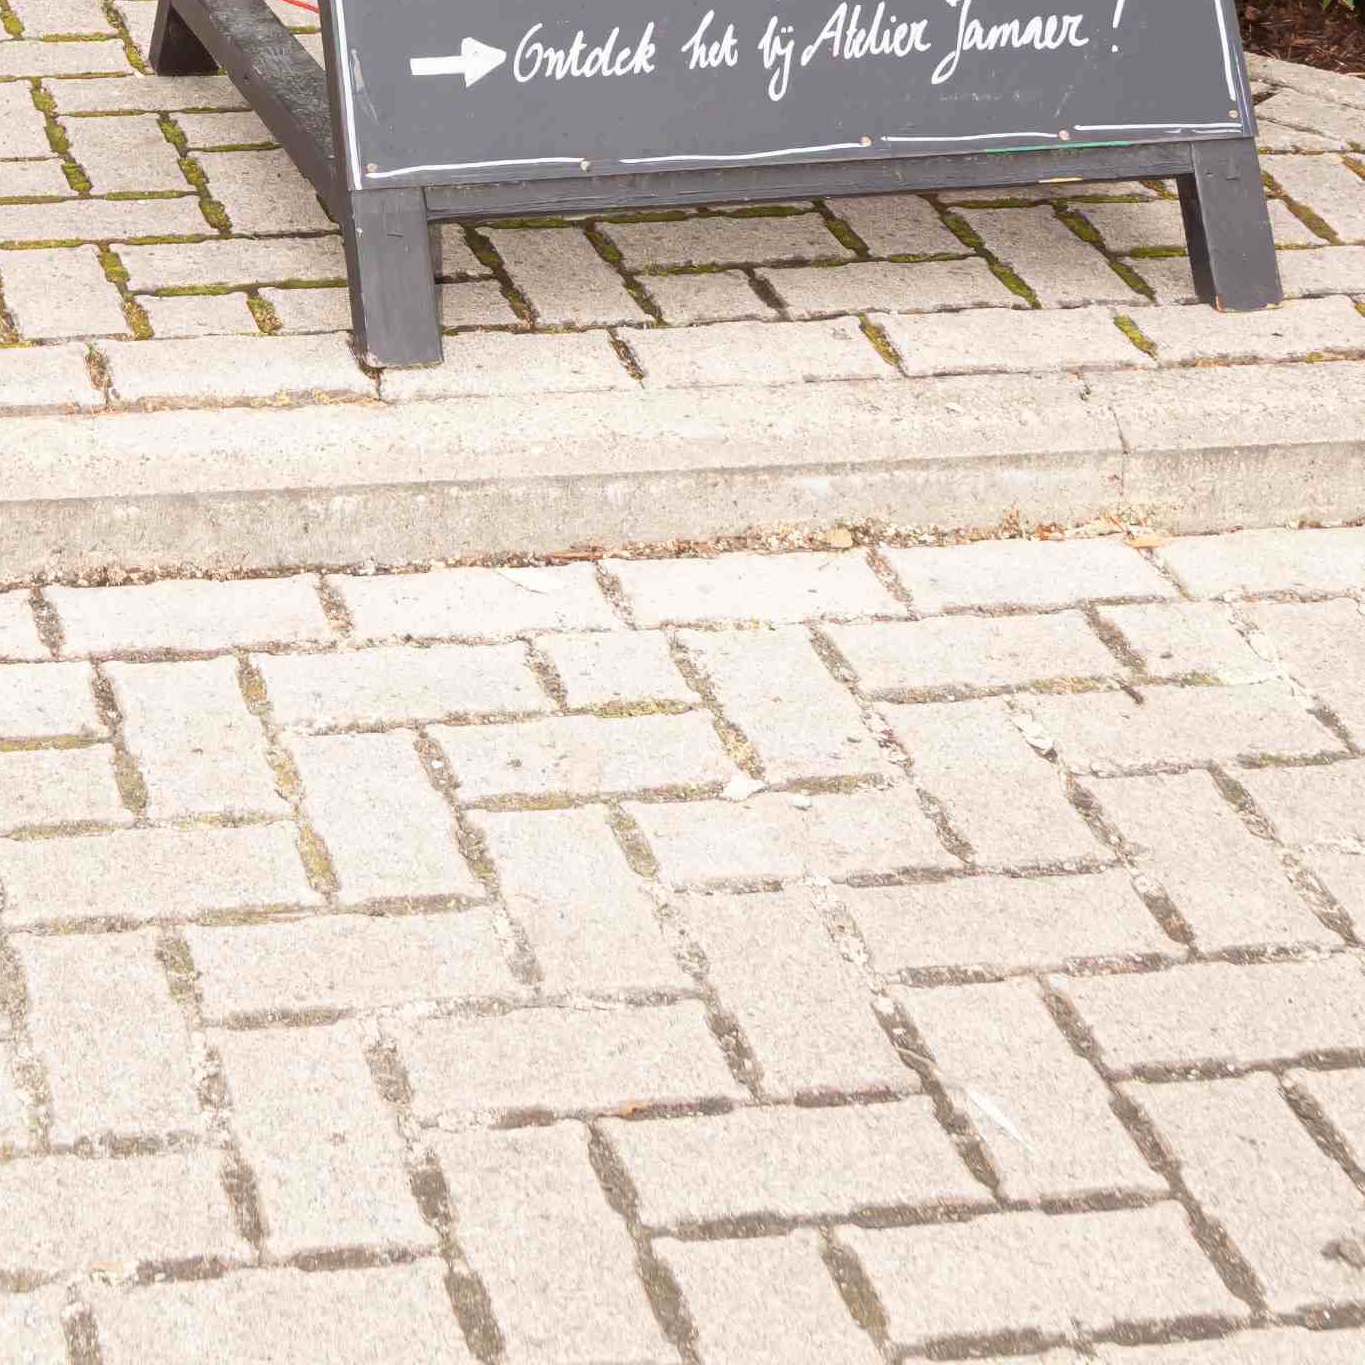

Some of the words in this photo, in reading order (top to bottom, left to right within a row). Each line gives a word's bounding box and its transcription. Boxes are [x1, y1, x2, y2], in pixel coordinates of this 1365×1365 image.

[513, 22, 656, 83] Ontdek
[681, 9, 739, 70] het
[757, 15, 795, 102] bij
[800, 1, 932, 67] Atelier
